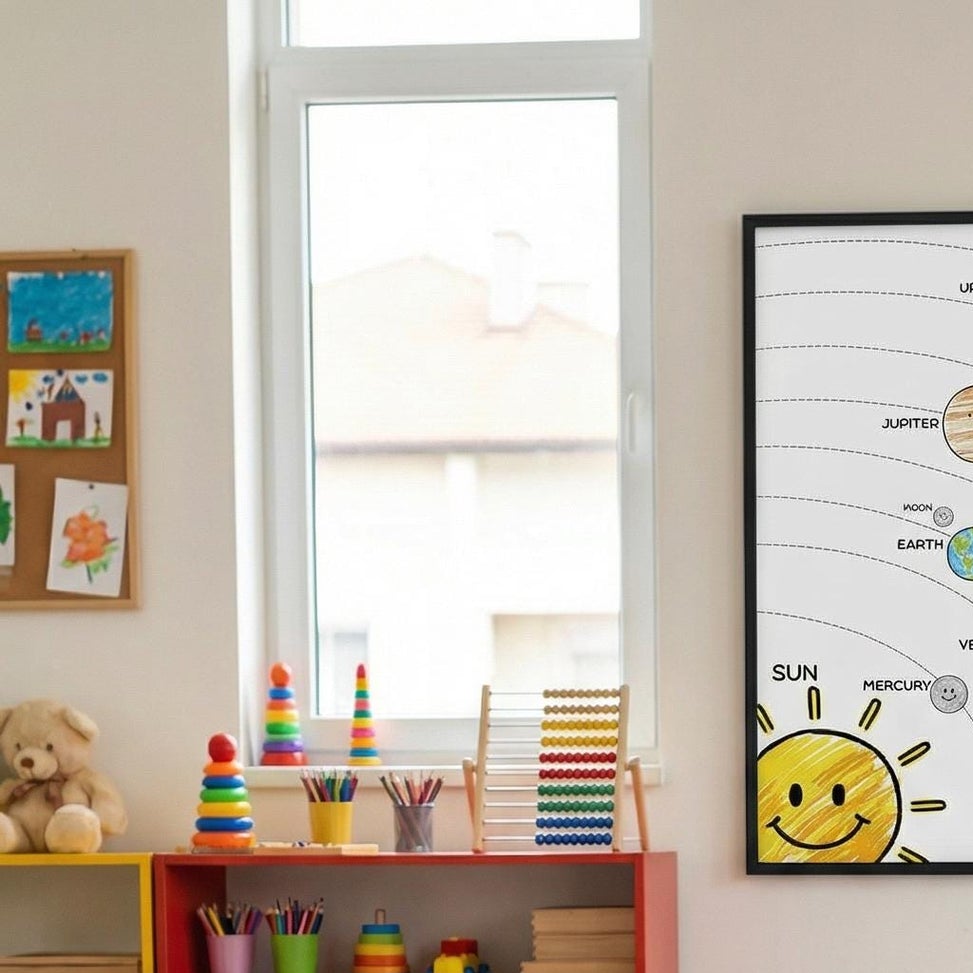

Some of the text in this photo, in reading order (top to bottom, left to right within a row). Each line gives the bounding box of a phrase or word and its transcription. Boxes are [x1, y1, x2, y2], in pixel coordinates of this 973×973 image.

[881, 417, 941, 430] JUPITER
[897, 538, 944, 551] EARTH
[771, 663, 818, 682] SUN
[862, 679, 932, 692] MERCURY
